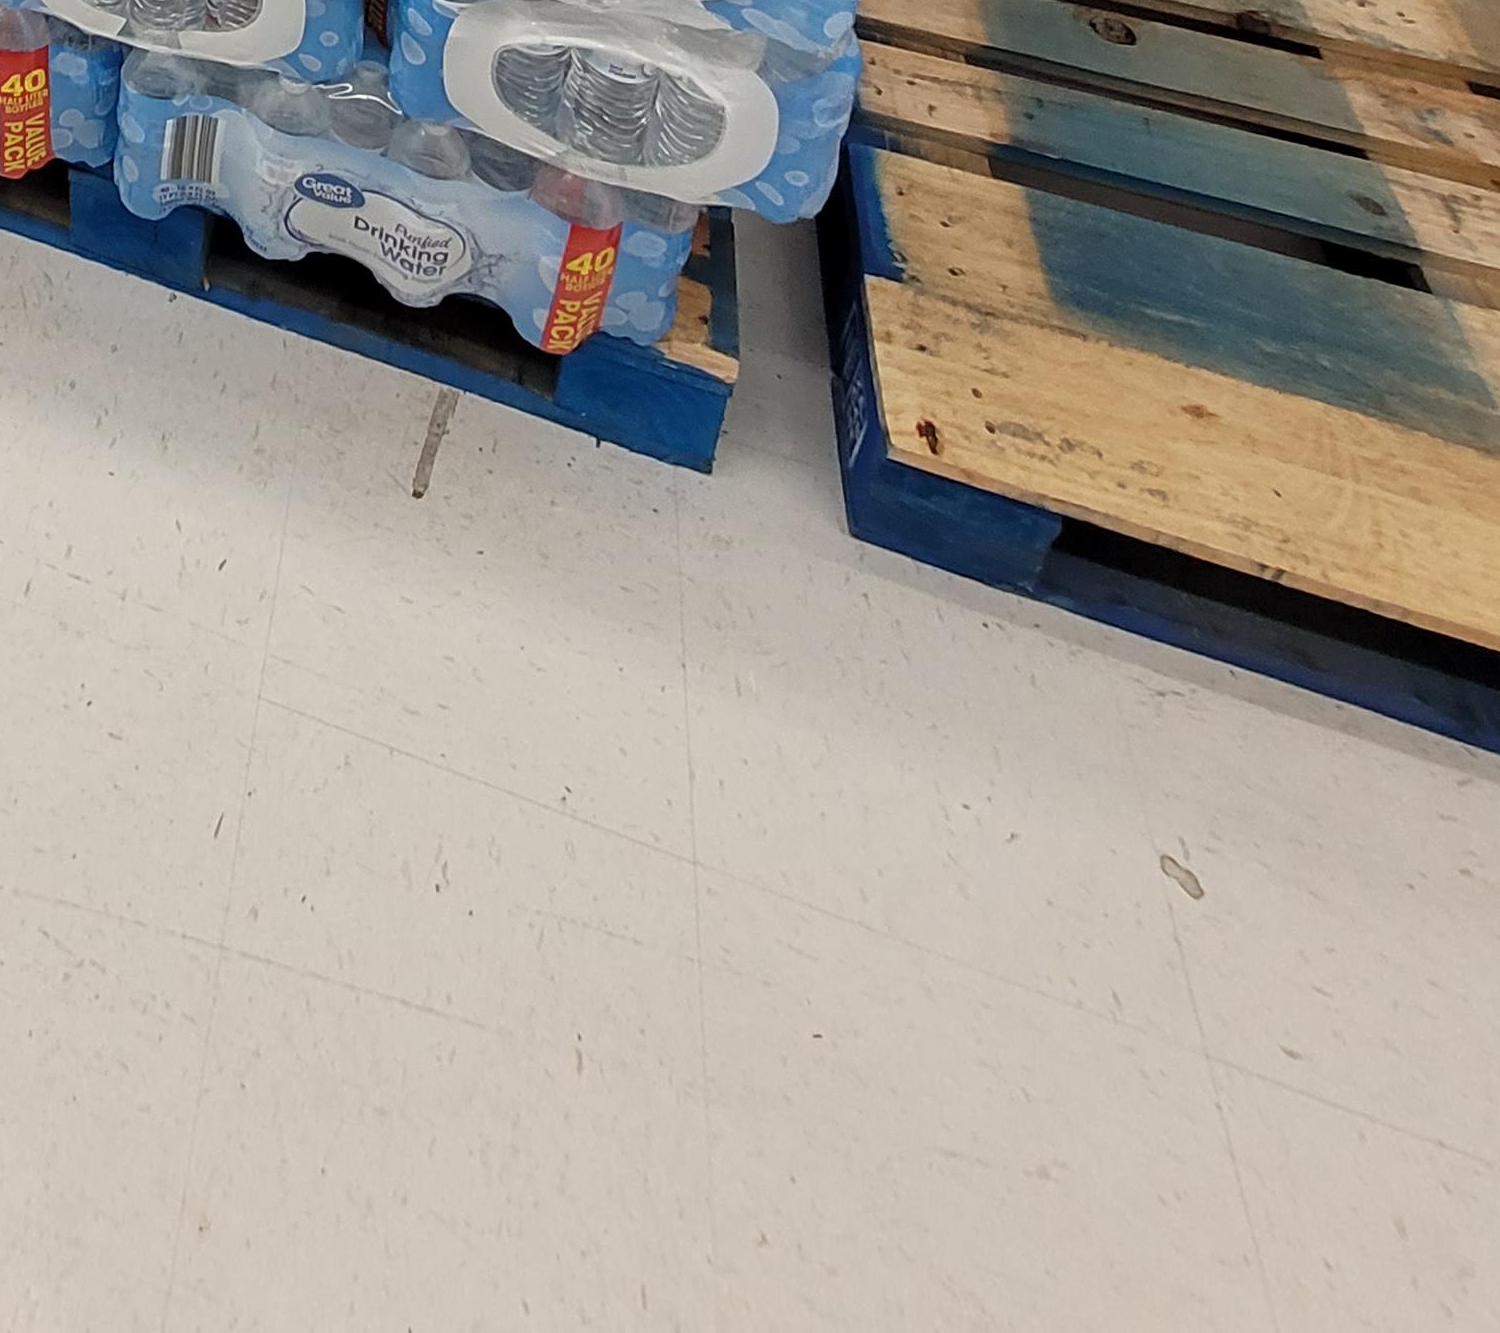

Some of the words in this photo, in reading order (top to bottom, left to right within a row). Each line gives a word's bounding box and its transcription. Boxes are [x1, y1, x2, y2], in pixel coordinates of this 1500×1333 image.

[1, 68, 46, 97] 40
[4, 121, 25, 173] PACK
[25, 112, 47, 168] VALUE
[302, 177, 353, 197] Great
[314, 186, 354, 205] Value
[354, 215, 449, 266] Drinking
[379, 241, 448, 278] Water
[565, 246, 615, 275] 40
[547, 299, 581, 350] PACK
